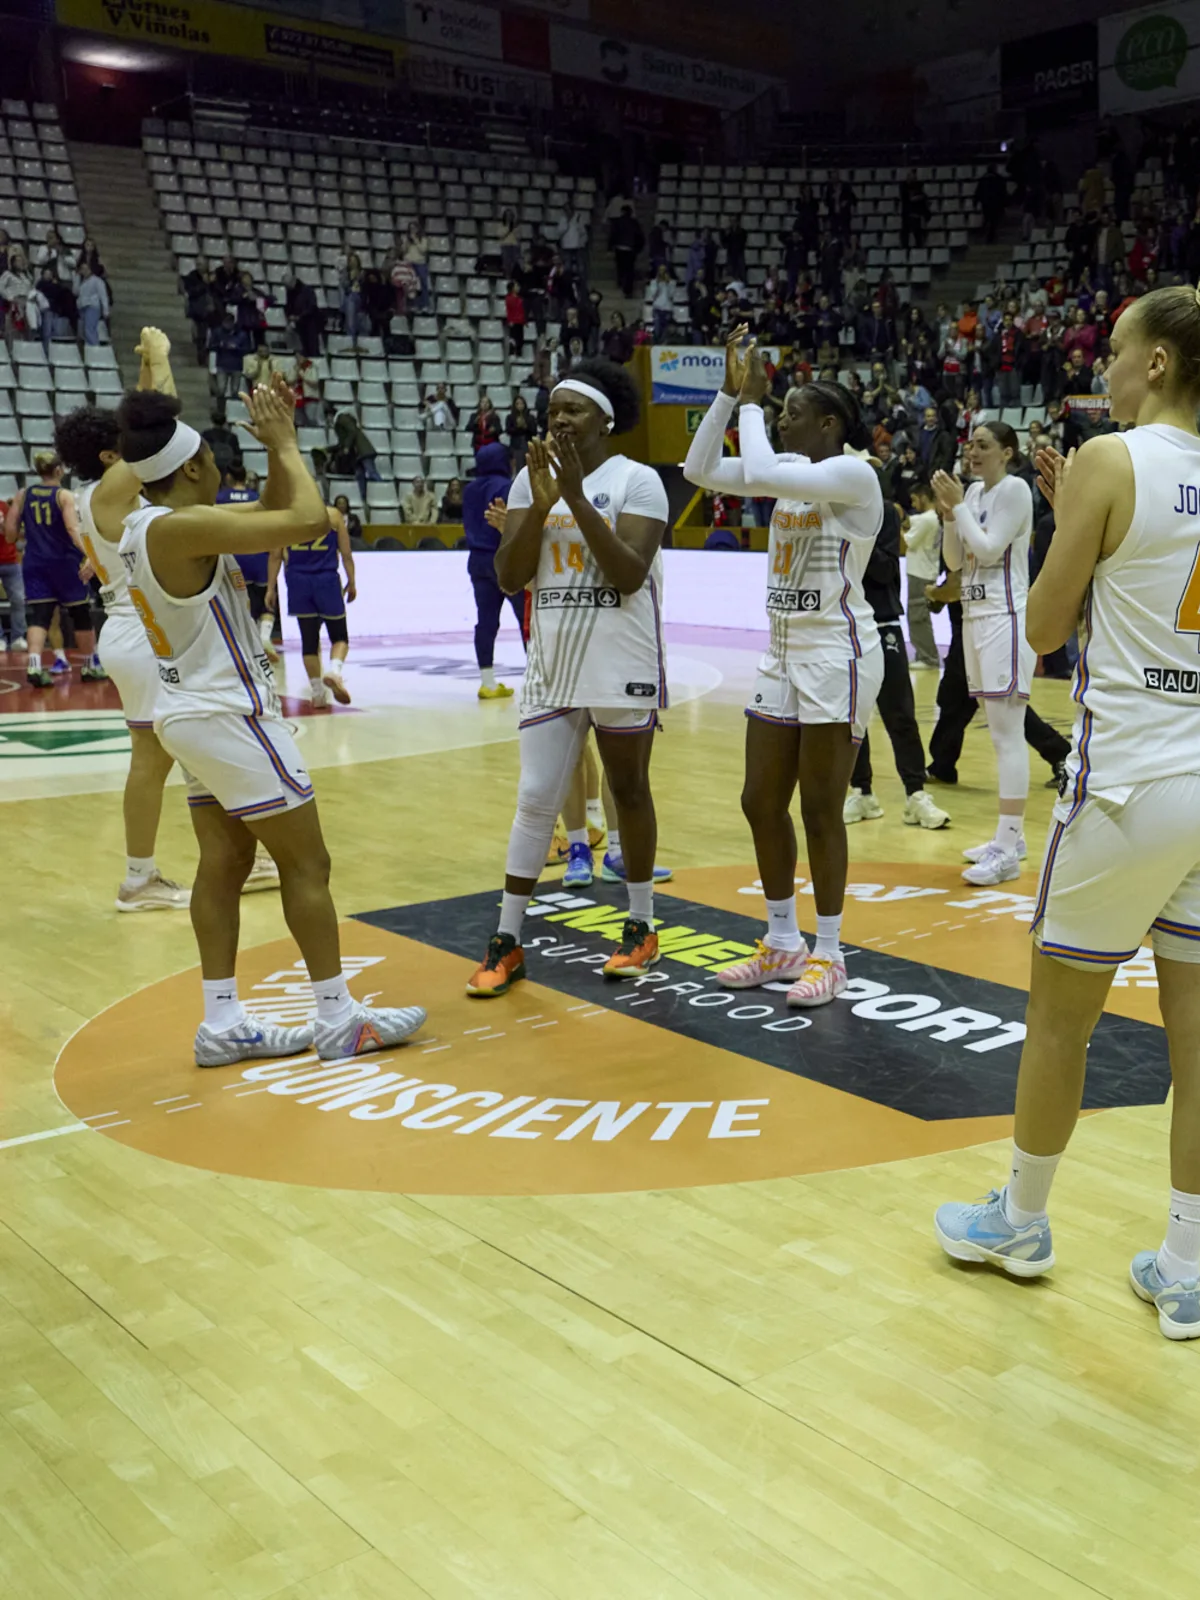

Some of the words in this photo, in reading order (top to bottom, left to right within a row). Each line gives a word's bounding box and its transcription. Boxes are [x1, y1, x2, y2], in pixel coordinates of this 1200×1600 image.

[641, 51, 685, 80] Sant
[30, 501, 53, 526] 11
[550, 541, 585, 574] 14
[541, 591, 593, 605] SPAR
[242, 1056, 770, 1141] CONSCIENTE
